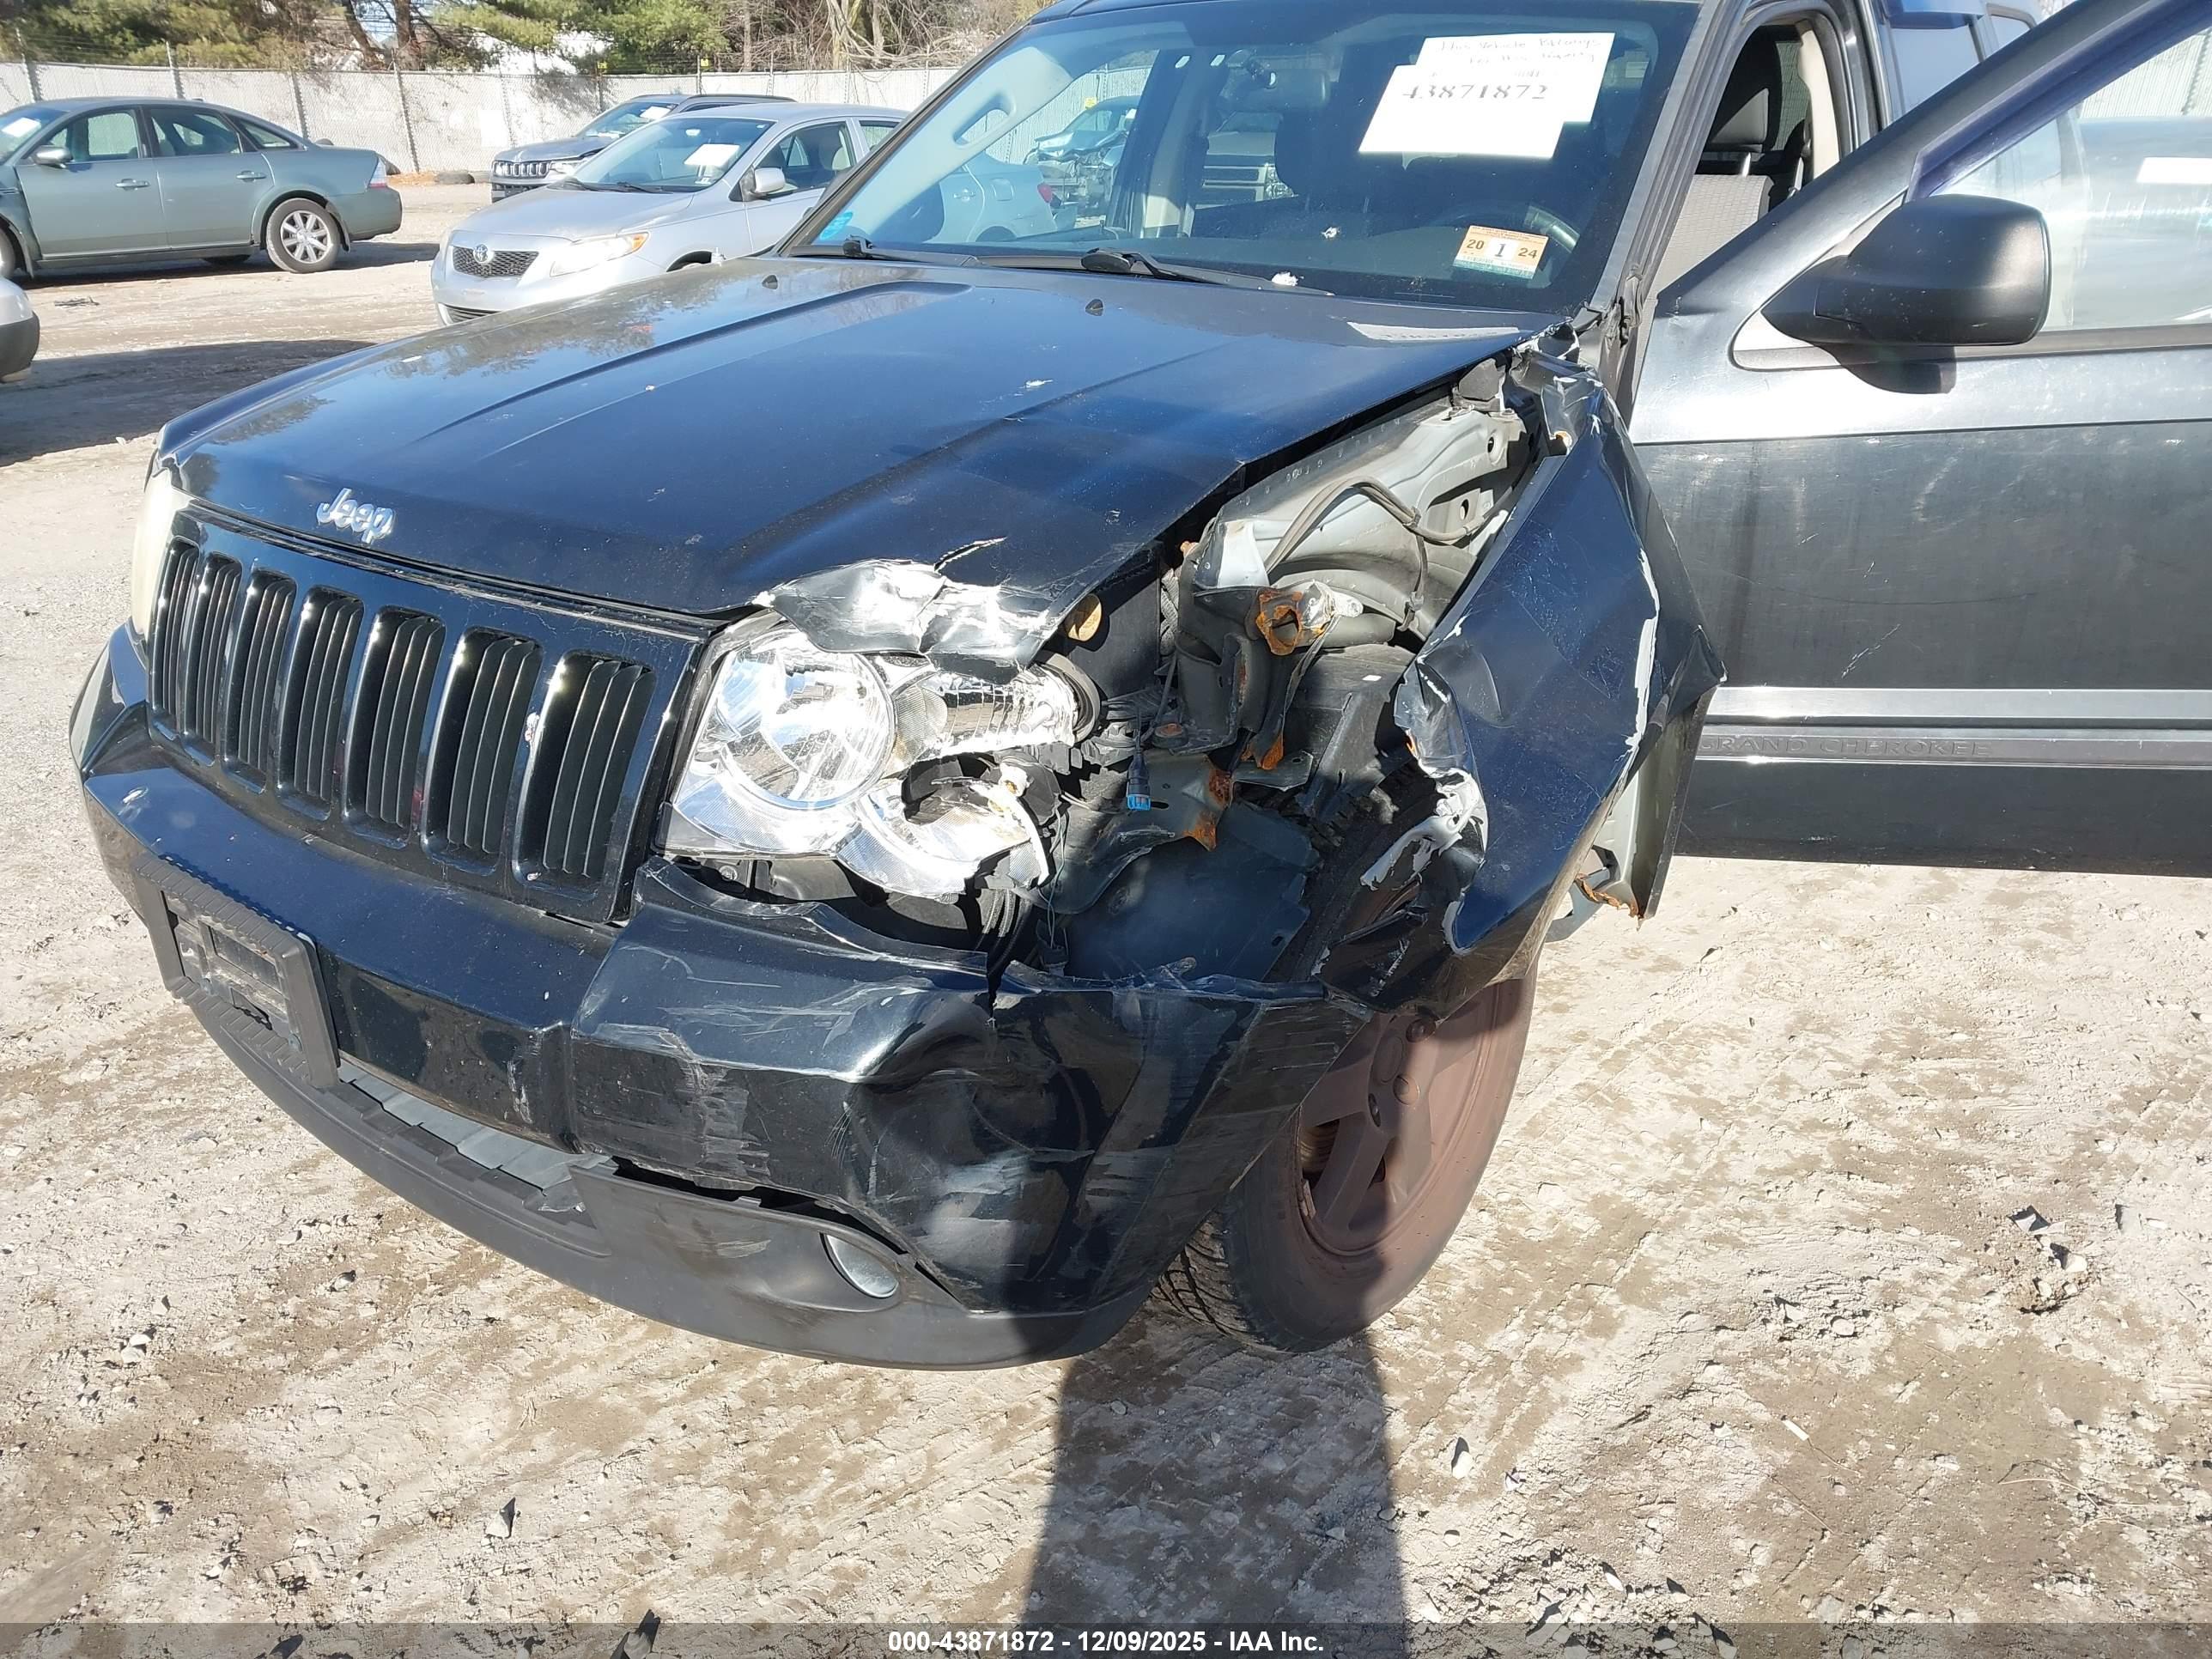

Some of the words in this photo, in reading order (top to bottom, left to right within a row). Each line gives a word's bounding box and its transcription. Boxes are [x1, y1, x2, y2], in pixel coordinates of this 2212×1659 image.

[1401, 84, 1549, 100] 43871872
[1466, 240, 1485, 250] 20
[1494, 243, 1507, 258] 1
[1518, 247, 1538, 259] 24
[315, 487, 395, 544] Jeep
[1699, 736, 1808, 753] GRAND
[1819, 738, 1992, 757] CHEROKEE
